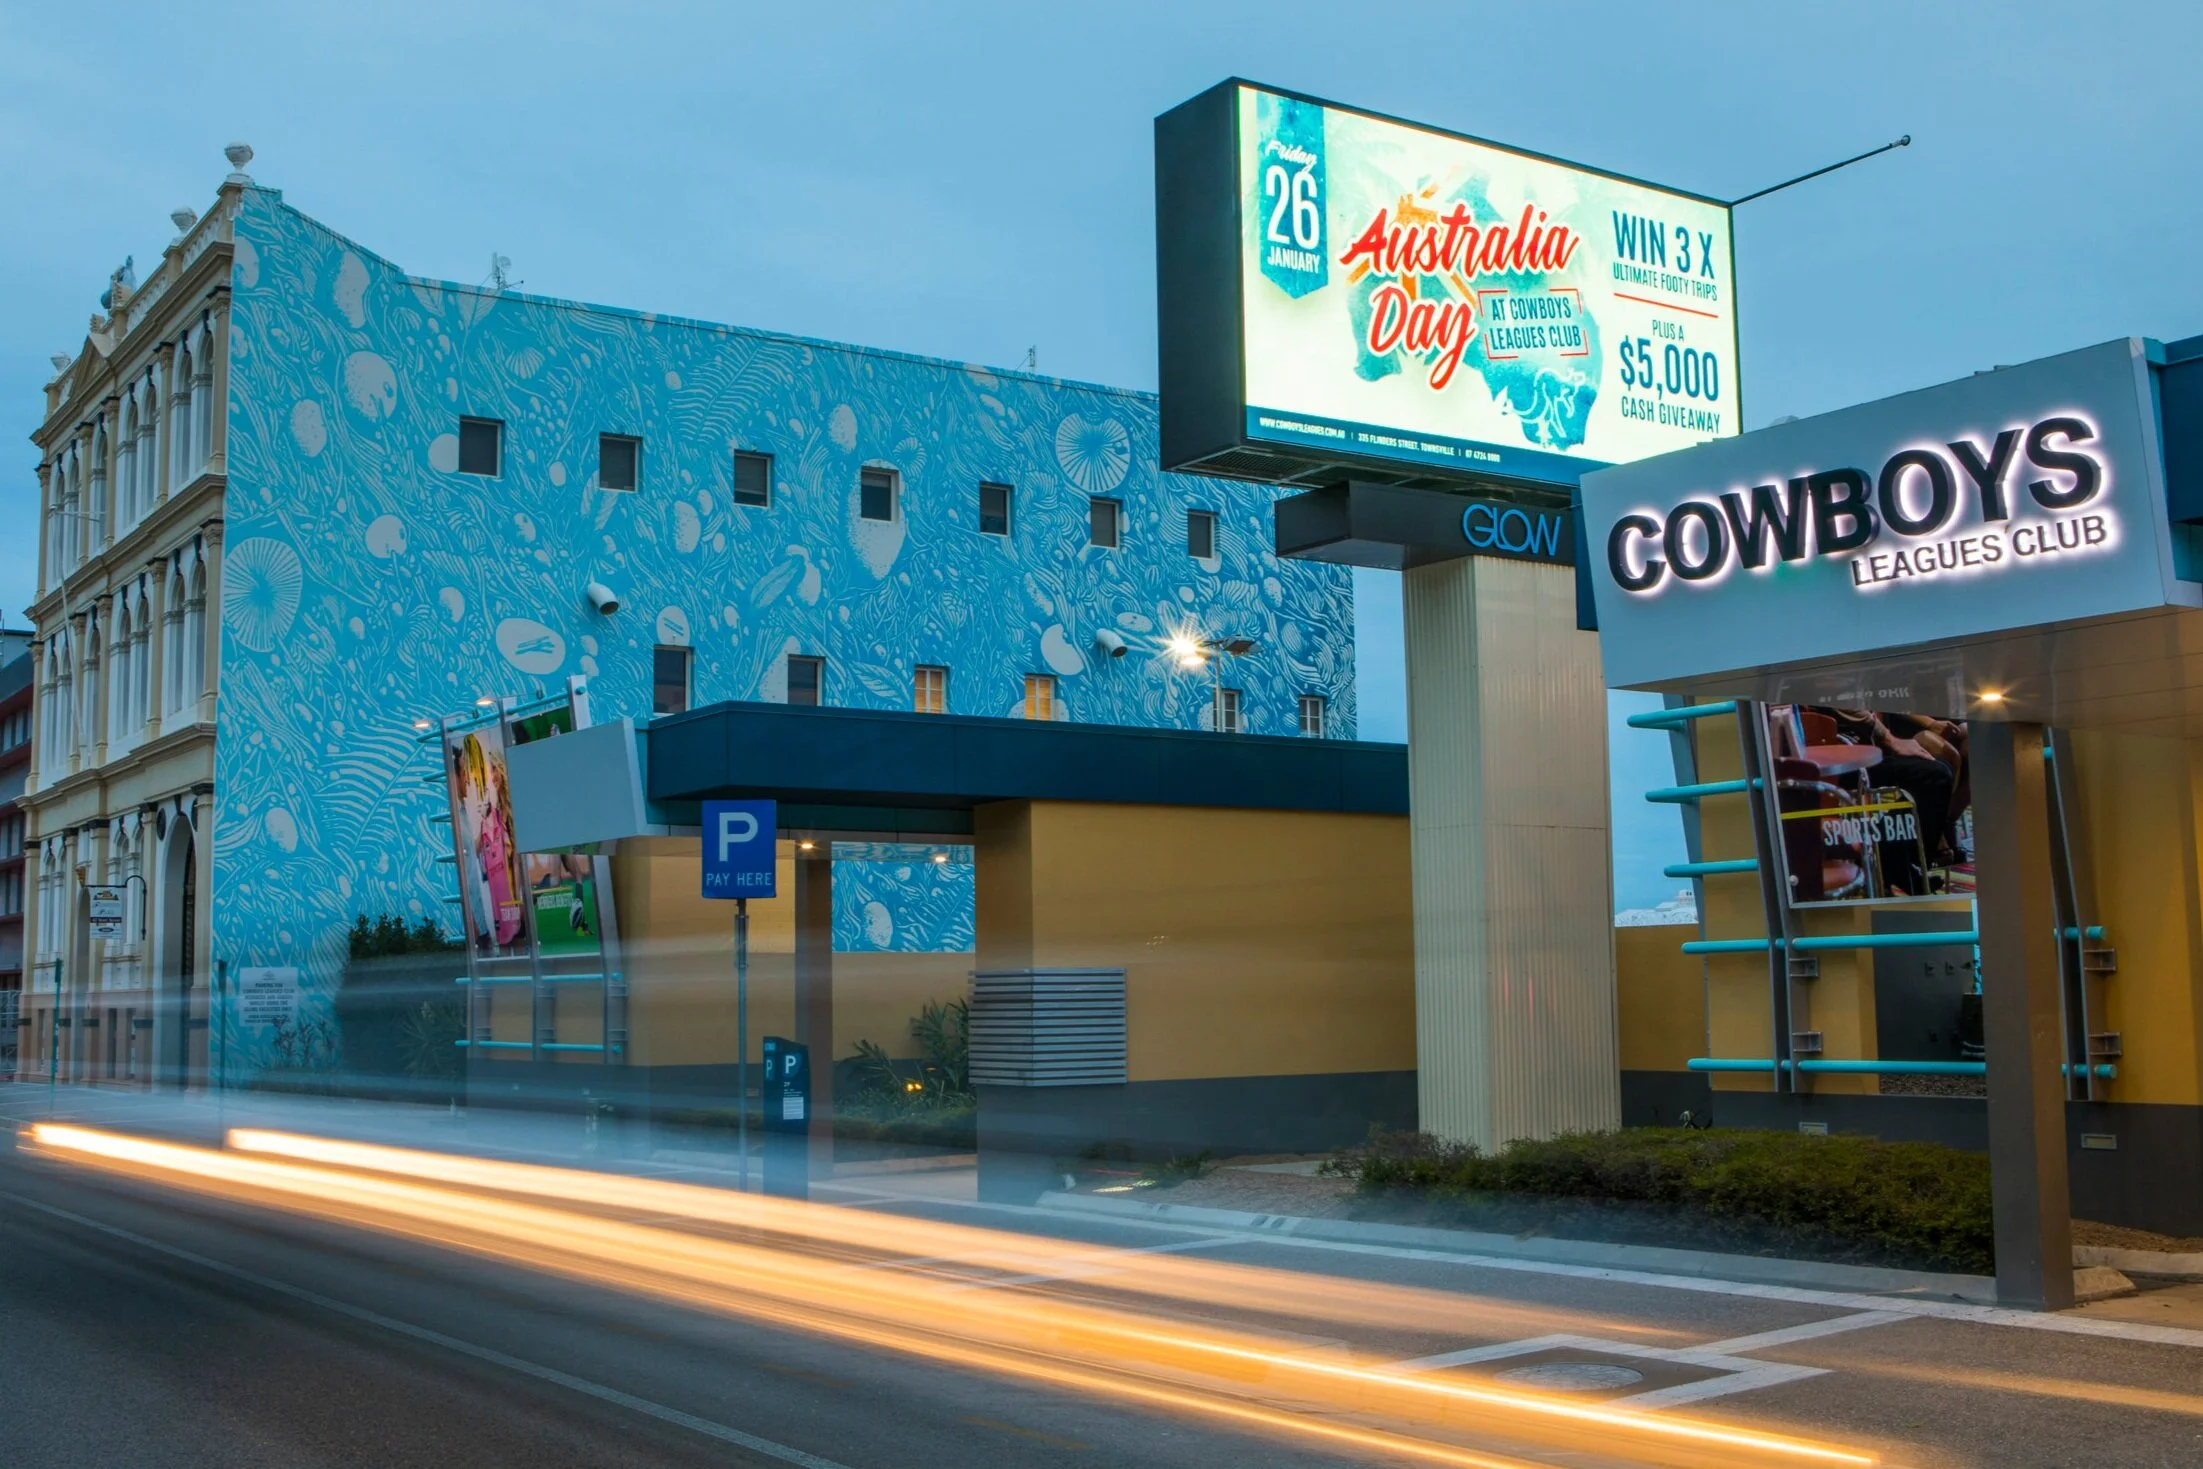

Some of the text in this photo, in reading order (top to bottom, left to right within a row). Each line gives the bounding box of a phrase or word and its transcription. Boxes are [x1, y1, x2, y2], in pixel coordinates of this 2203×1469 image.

[1265, 139, 1317, 172] Friday
[1265, 164, 1320, 250] 26
[1267, 245, 1320, 274] JANUARY
[1339, 203, 1580, 278] Australia
[1612, 210, 1715, 280] WIN 3 X
[1613, 261, 1718, 302] ULTIMATE FOOTY TRIPS
[1491, 297, 1572, 320] AT COWBOYS
[1369, 286, 1476, 390] Day
[1489, 325, 1582, 350] LEAGUES CLUB
[1652, 319, 1685, 341] PLUS A
[1619, 334, 1719, 402] $5,000
[1621, 395, 1720, 434] CASH GIVEAWAY
[1607, 416, 2102, 592] COWBOYS
[1463, 503, 1561, 556] GLOW
[1851, 514, 2108, 586] LEAGUES CLUB
[719, 812, 759, 861] P
[1823, 813, 1918, 847] SPORTS BAR
[706, 872, 773, 887] PAY HERE
[785, 1055, 797, 1074] P
